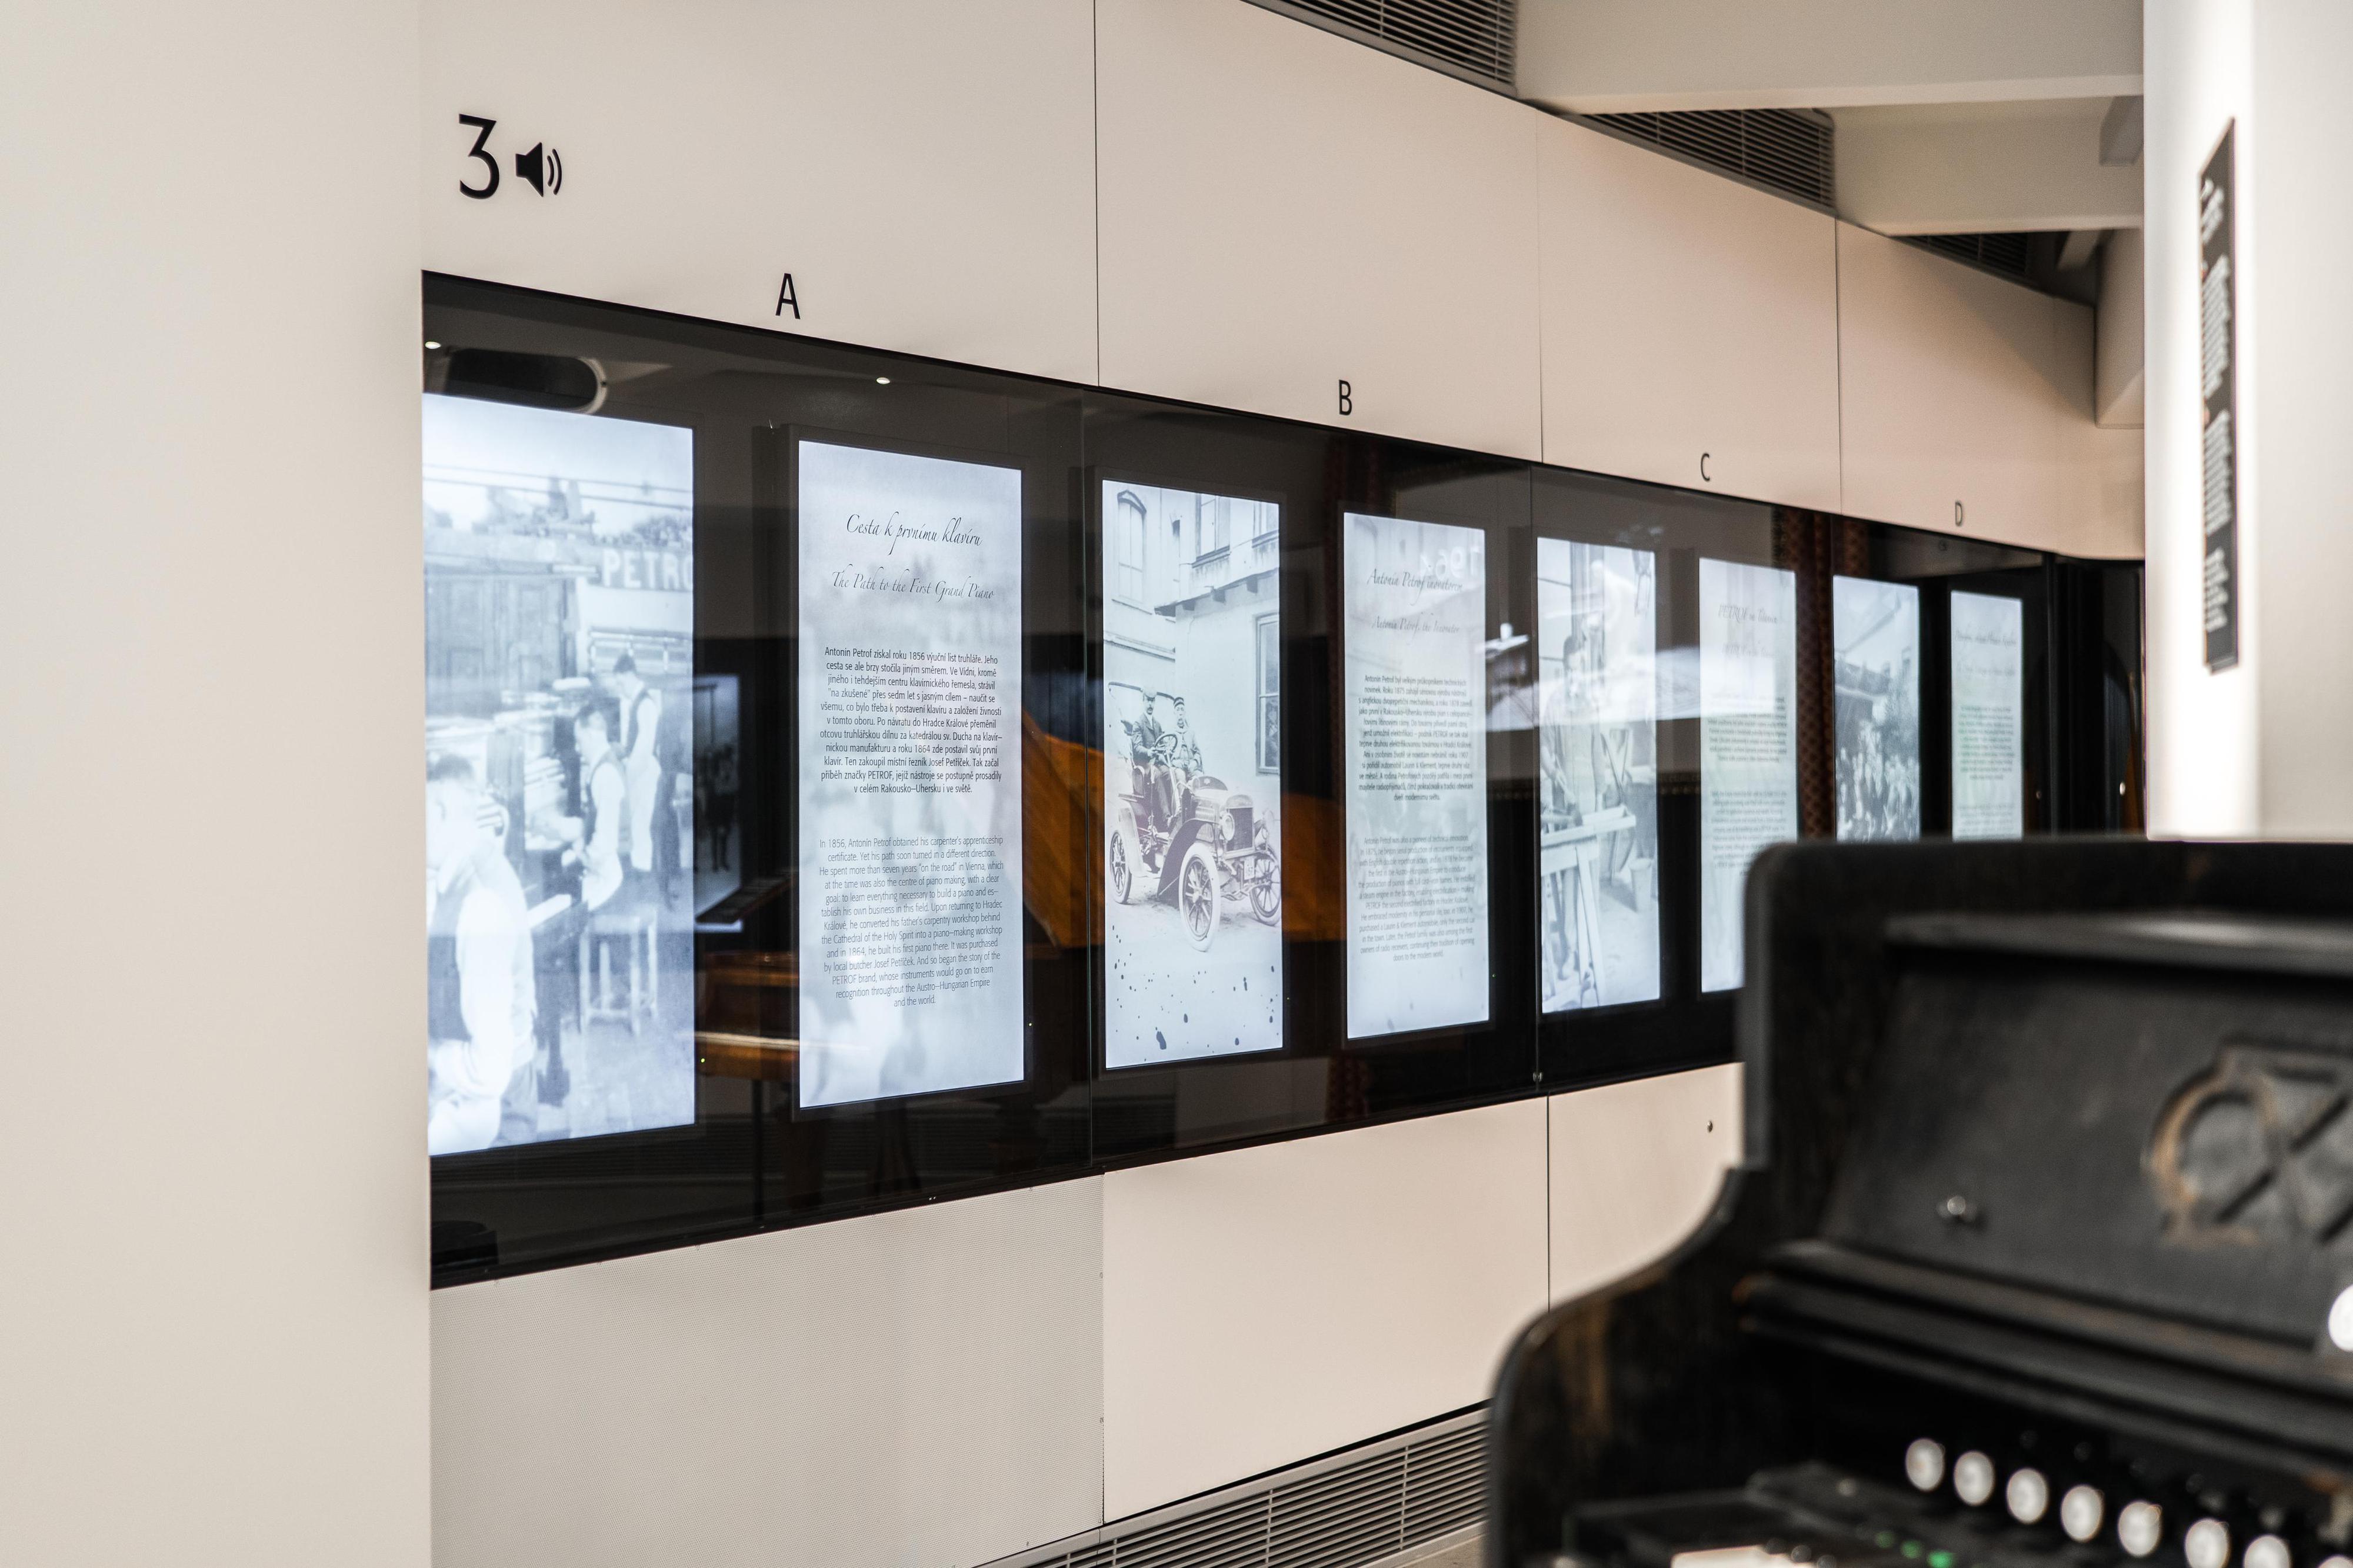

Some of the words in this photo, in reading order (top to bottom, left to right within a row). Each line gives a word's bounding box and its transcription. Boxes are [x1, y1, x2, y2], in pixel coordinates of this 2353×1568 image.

[459, 114, 499, 199] 3
[775, 273, 801, 319] A
[1339, 379, 1352, 416] B
[1701, 453, 1710, 482] C
[1955, 501, 1963, 527] D
[846, 513, 880, 535] Cesta
[885, 511, 899, 536] k
[942, 517, 983, 546] klavíru
[888, 523, 938, 556] prvnímu
[832, 563, 853, 588] The
[853, 566, 884, 590] Path
[879, 578, 889, 590] to
[892, 569, 910, 592] the
[909, 578, 932, 595] First
[935, 576, 971, 602] Grand
[968, 583, 995, 599] Piano
[852, 647, 872, 658] Petrof
[892, 649, 906, 660] roku
[909, 650, 925, 660] 1856
[947, 652, 956, 662] list
[984, 654, 998, 665] Jeho
[826, 661, 843, 670] cesta
[854, 660, 864, 671] ale
[865, 661, 879, 675] brzy
[949, 666, 958, 675] Ve
[888, 678, 908, 686] centru
[887, 689, 905, 699] sedm
[906, 690, 915, 700] let
[855, 702, 869, 715] bylo
[832, 716, 852, 725] tomto
[854, 715, 875, 726] oboru.
[877, 716, 885, 726] Po
[912, 717, 921, 726] do
[922, 717, 944, 727] Hradce
[819, 729, 842, 738] otcovu
[952, 731, 972, 741] Ducha
[825, 742, 848, 752] nickou
[849, 742, 891, 753] manufakturu
[898, 743, 912, 753] roku
[915, 744, 930, 753] 1864
[932, 743, 943, 753] zde
[945, 744, 968, 757] postavil
[845, 756, 856, 766] Ten
[858, 756, 885, 769] zakoupil
[928, 757, 944, 766] Josef
[972, 758, 982, 767] Tak
[868, 770, 894, 782] PETROF,
[975, 770, 1002, 783] prosadily
[819, 838, 825, 847] In
[828, 837, 846, 849] 1856,
[874, 835, 891, 846] Petrof
[892, 835, 918, 845] obtained
[920, 835, 928, 845] his
[962, 833, 1003, 846] apprenticeship
[849, 918, 858, 928] he
[859, 916, 889, 928] converted
[891, 915, 899, 926] his
[924, 914, 951, 927] carpentry
[951, 911, 979, 925] workshop
[981, 910, 1000, 920] behind
[835, 985, 869, 1000] recognition
[871, 982, 904, 997] throughout
[905, 981, 915, 992] the
[970, 976, 990, 989] Empire
